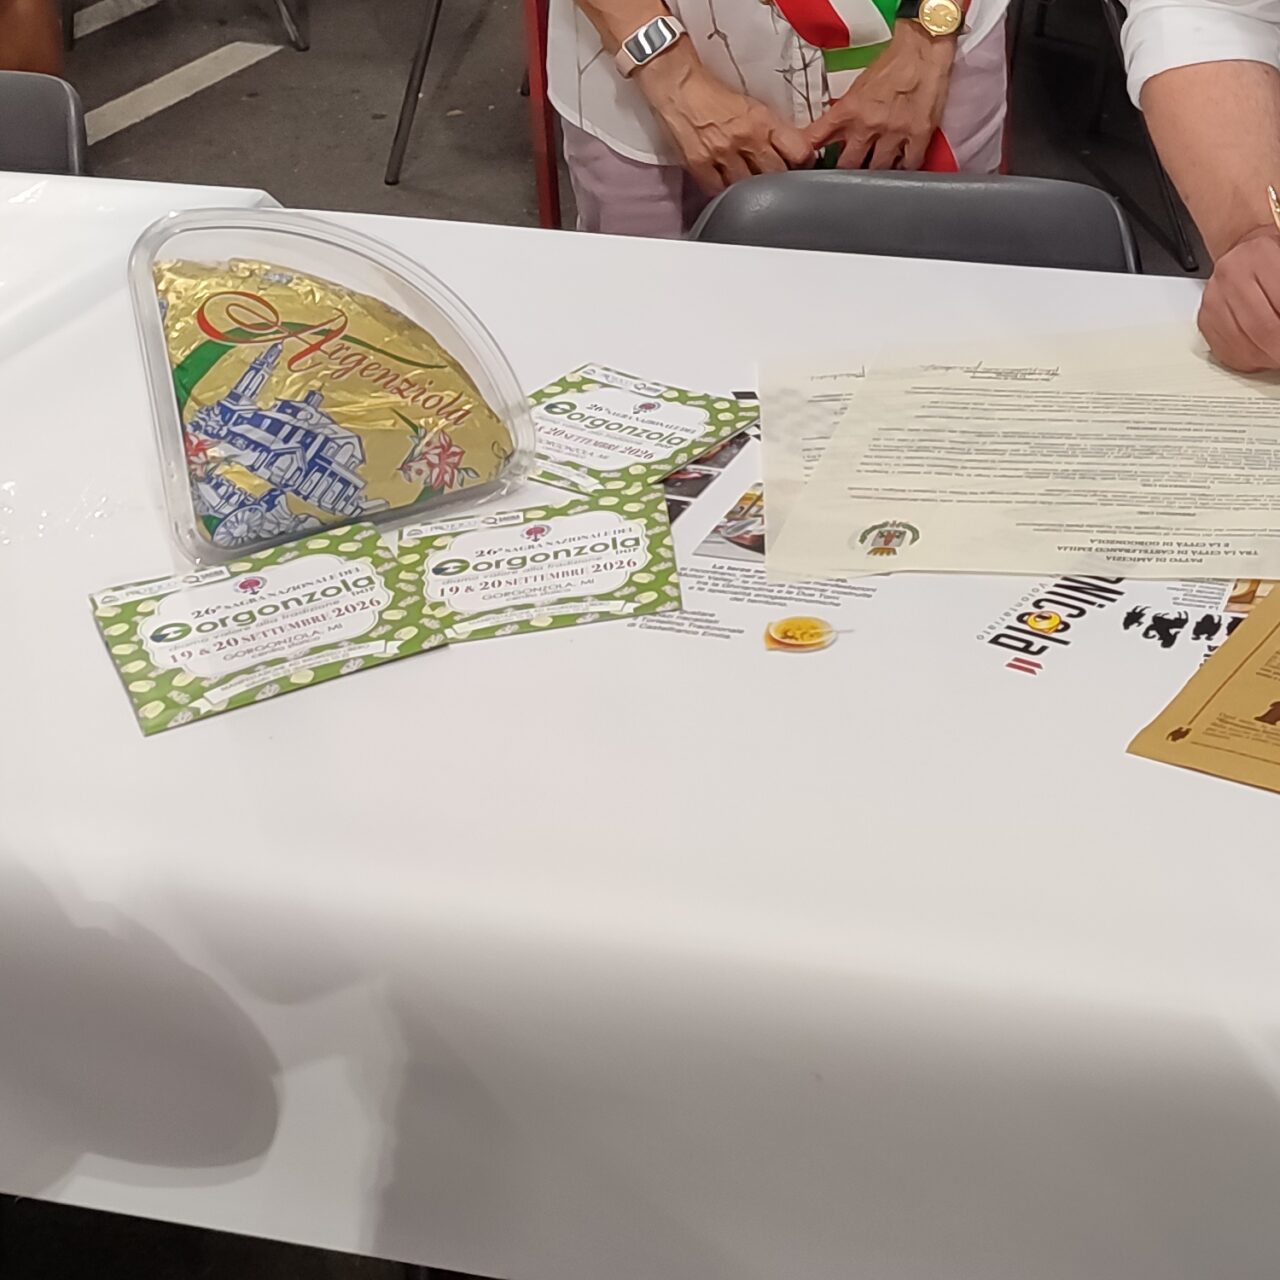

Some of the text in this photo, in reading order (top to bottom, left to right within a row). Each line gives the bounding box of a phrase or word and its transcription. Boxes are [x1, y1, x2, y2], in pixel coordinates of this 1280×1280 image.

[439, 585, 460, 597] 19
[479, 579, 503, 591] 20
[504, 568, 586, 588] SETTEMBRE
[591, 558, 638, 573] 2026
[170, 649, 194, 664] 19
[215, 637, 240, 654] 20
[241, 614, 331, 646] SETTEMBRE
[332, 597, 382, 619] 2026
